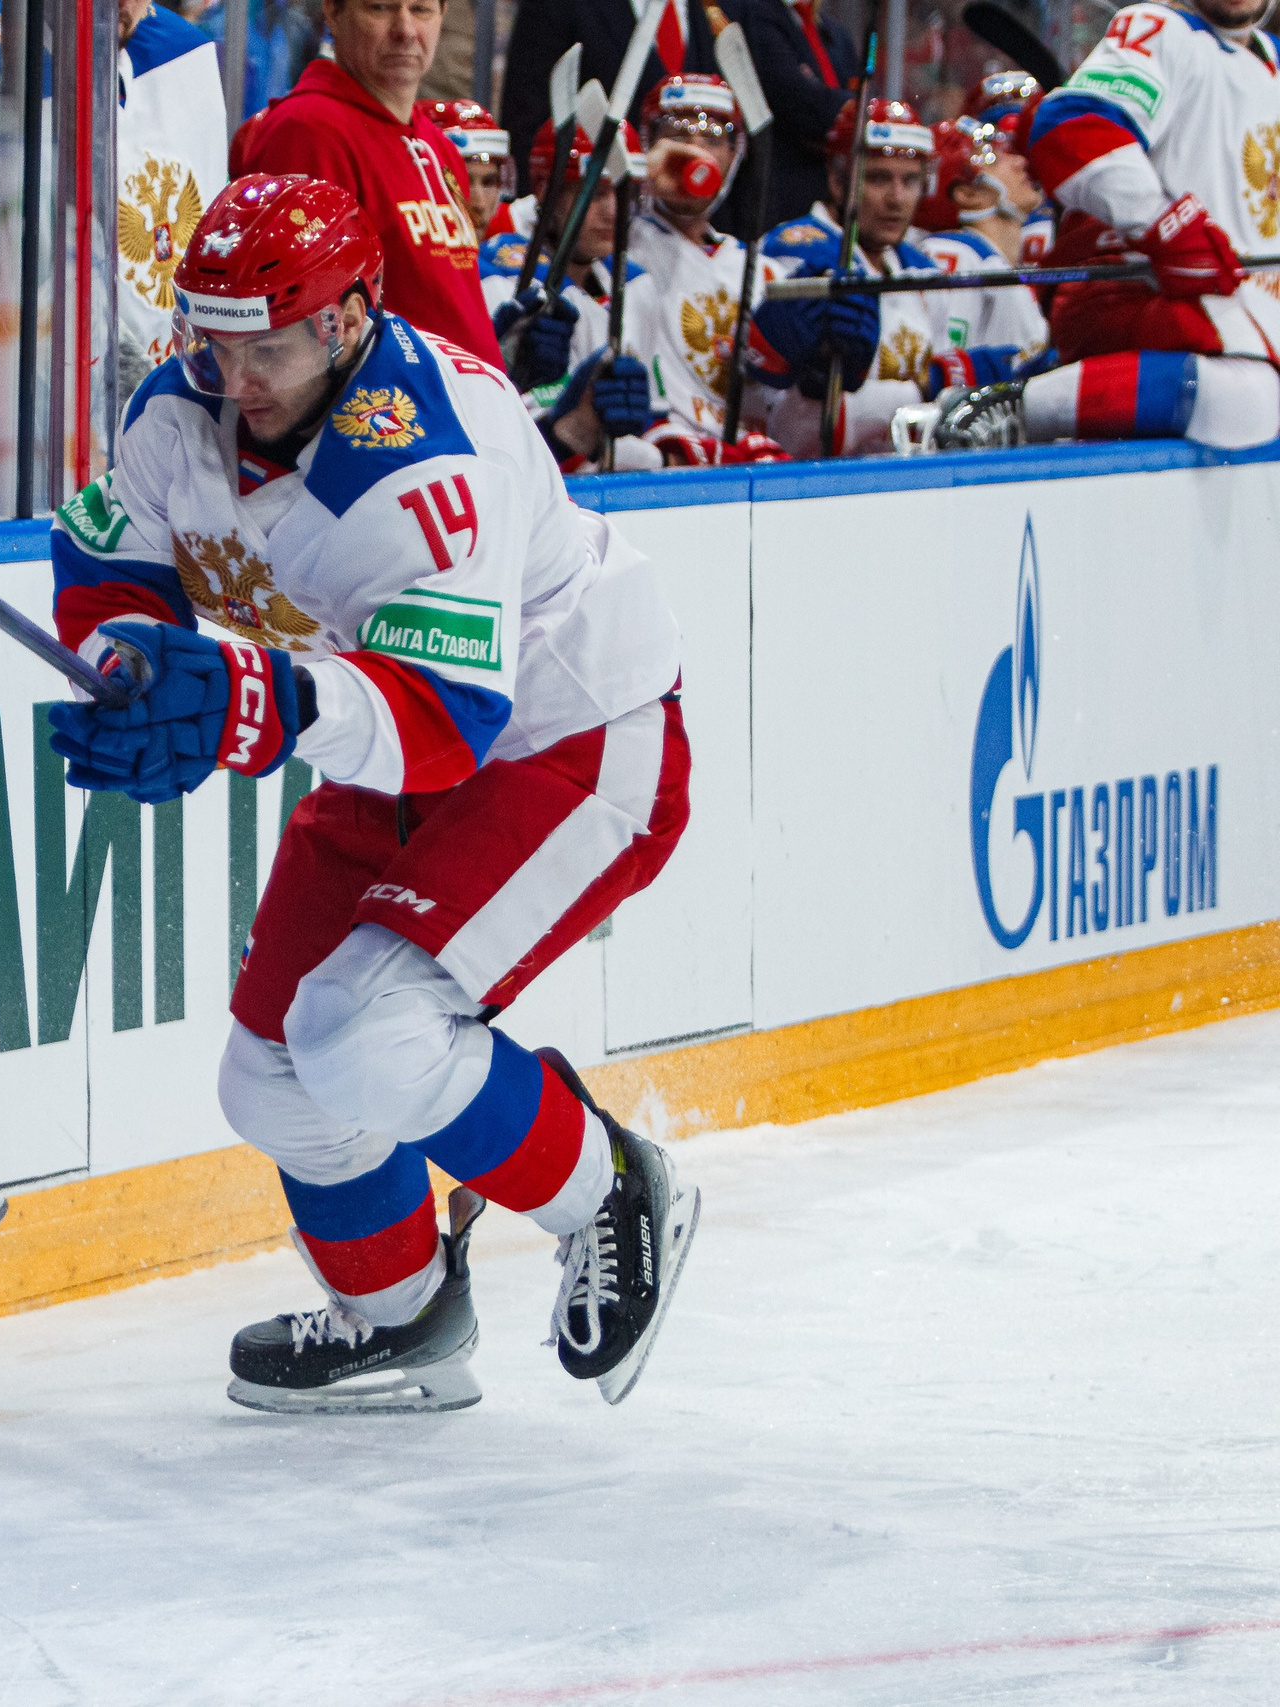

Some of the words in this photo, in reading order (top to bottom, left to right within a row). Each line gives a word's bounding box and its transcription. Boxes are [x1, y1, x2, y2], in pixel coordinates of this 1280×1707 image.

[1106, 13, 1166, 58] 42
[200, 228, 244, 259] 14
[193, 302, 265, 318] НОРНИКЕЛЬ
[397, 473, 478, 572] 14
[226, 641, 266, 765] CCM
[1049, 763, 1220, 942] ГАЗПРОМ
[359, 882, 438, 915] CCM
[639, 1214, 654, 1287] BAUER
[328, 1348, 392, 1380] BAUER
